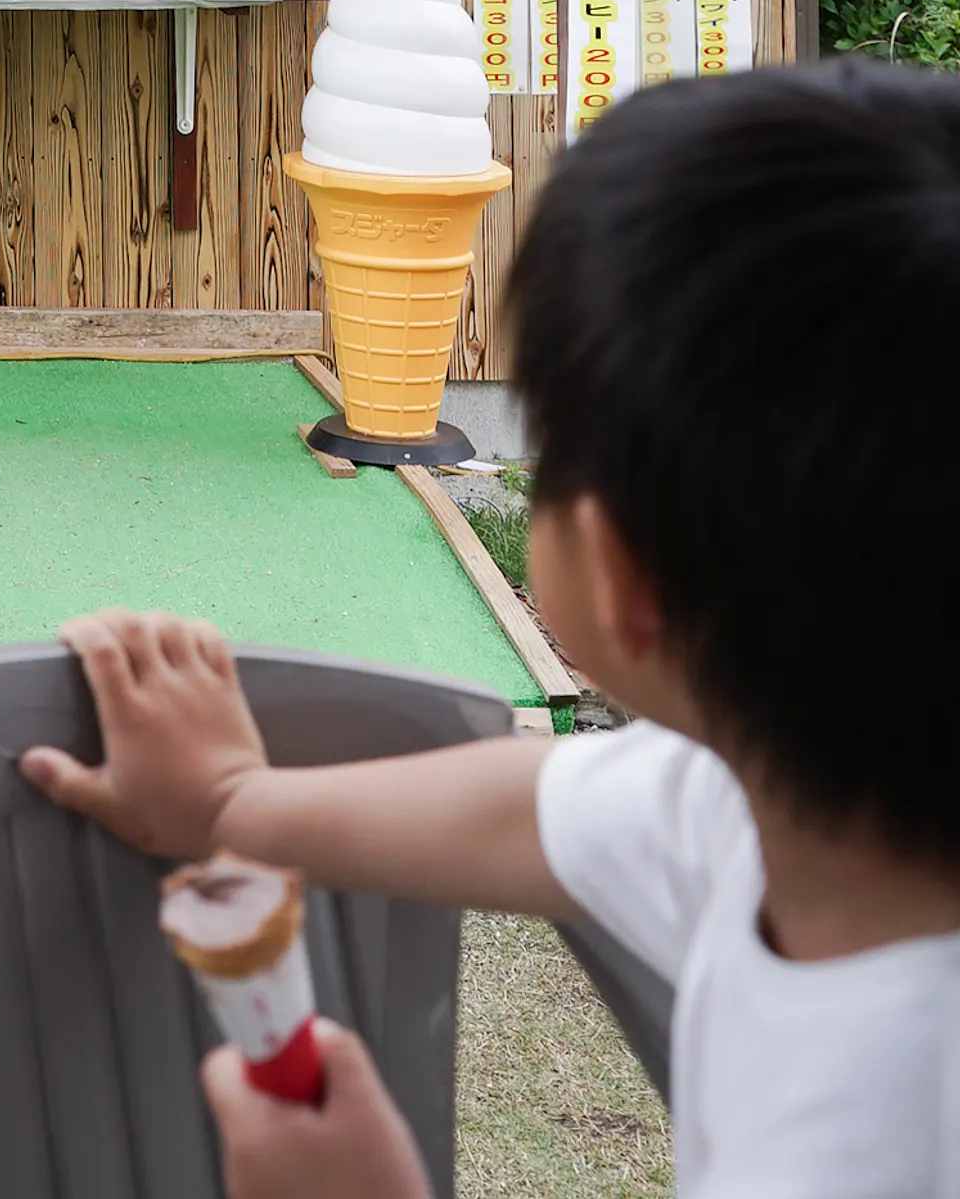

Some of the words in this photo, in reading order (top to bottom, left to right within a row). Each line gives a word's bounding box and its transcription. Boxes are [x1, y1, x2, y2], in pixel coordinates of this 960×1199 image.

[330, 207, 454, 244] スジャータ
